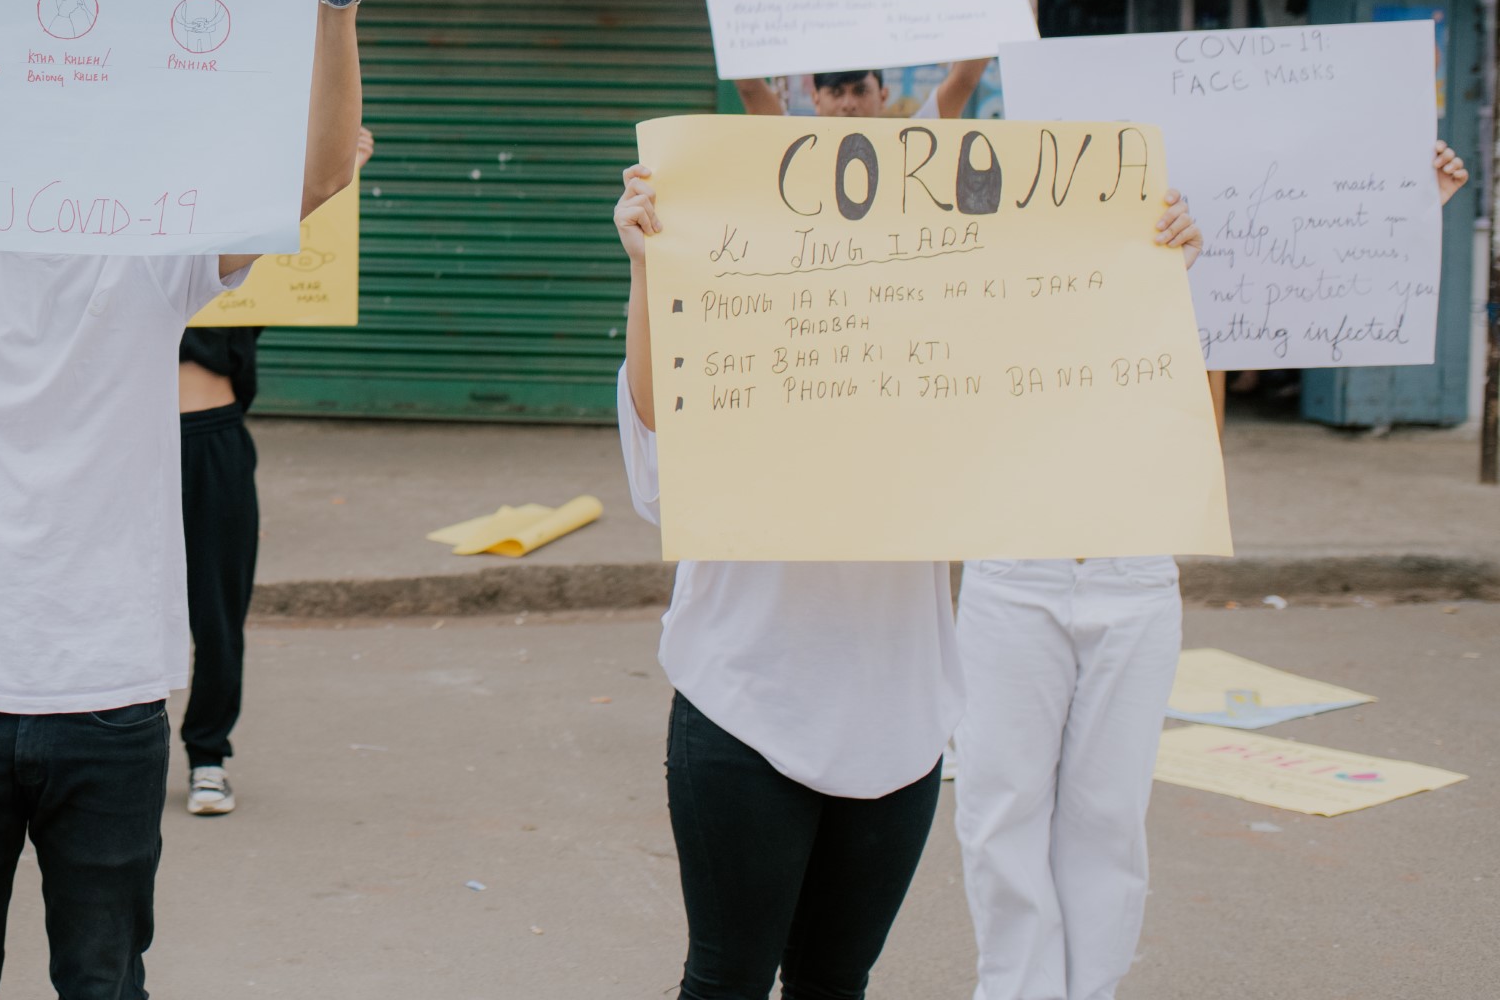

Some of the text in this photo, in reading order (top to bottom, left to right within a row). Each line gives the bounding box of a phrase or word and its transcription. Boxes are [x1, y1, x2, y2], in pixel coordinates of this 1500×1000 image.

[1171, 63, 1335, 96] FACE MASKS
[778, 126, 1149, 221] CORONA
[1213, 185, 1238, 201] a
[1333, 171, 1386, 193] masks
[1398, 176, 1417, 191] in
[26, 180, 199, 236] COVID-19
[709, 223, 750, 263] KI
[1215, 210, 1269, 256] help
[701, 289, 773, 322] PHONG
[791, 291, 813, 311] IA
[828, 288, 848, 308] KI
[944, 280, 968, 299] HA
[984, 278, 1007, 300] KI
[1025, 270, 1104, 298] JAKA
[1210, 273, 1255, 305] not
[1265, 269, 1372, 328] protect
[703, 339, 951, 378] SAIT BHA IA KI KTI
[1197, 313, 1409, 362] getting infected
[711, 384, 758, 412] WAT
[782, 375, 858, 404] PHONG
[917, 374, 982, 400] JAIN
[1110, 352, 1174, 387] BAR
